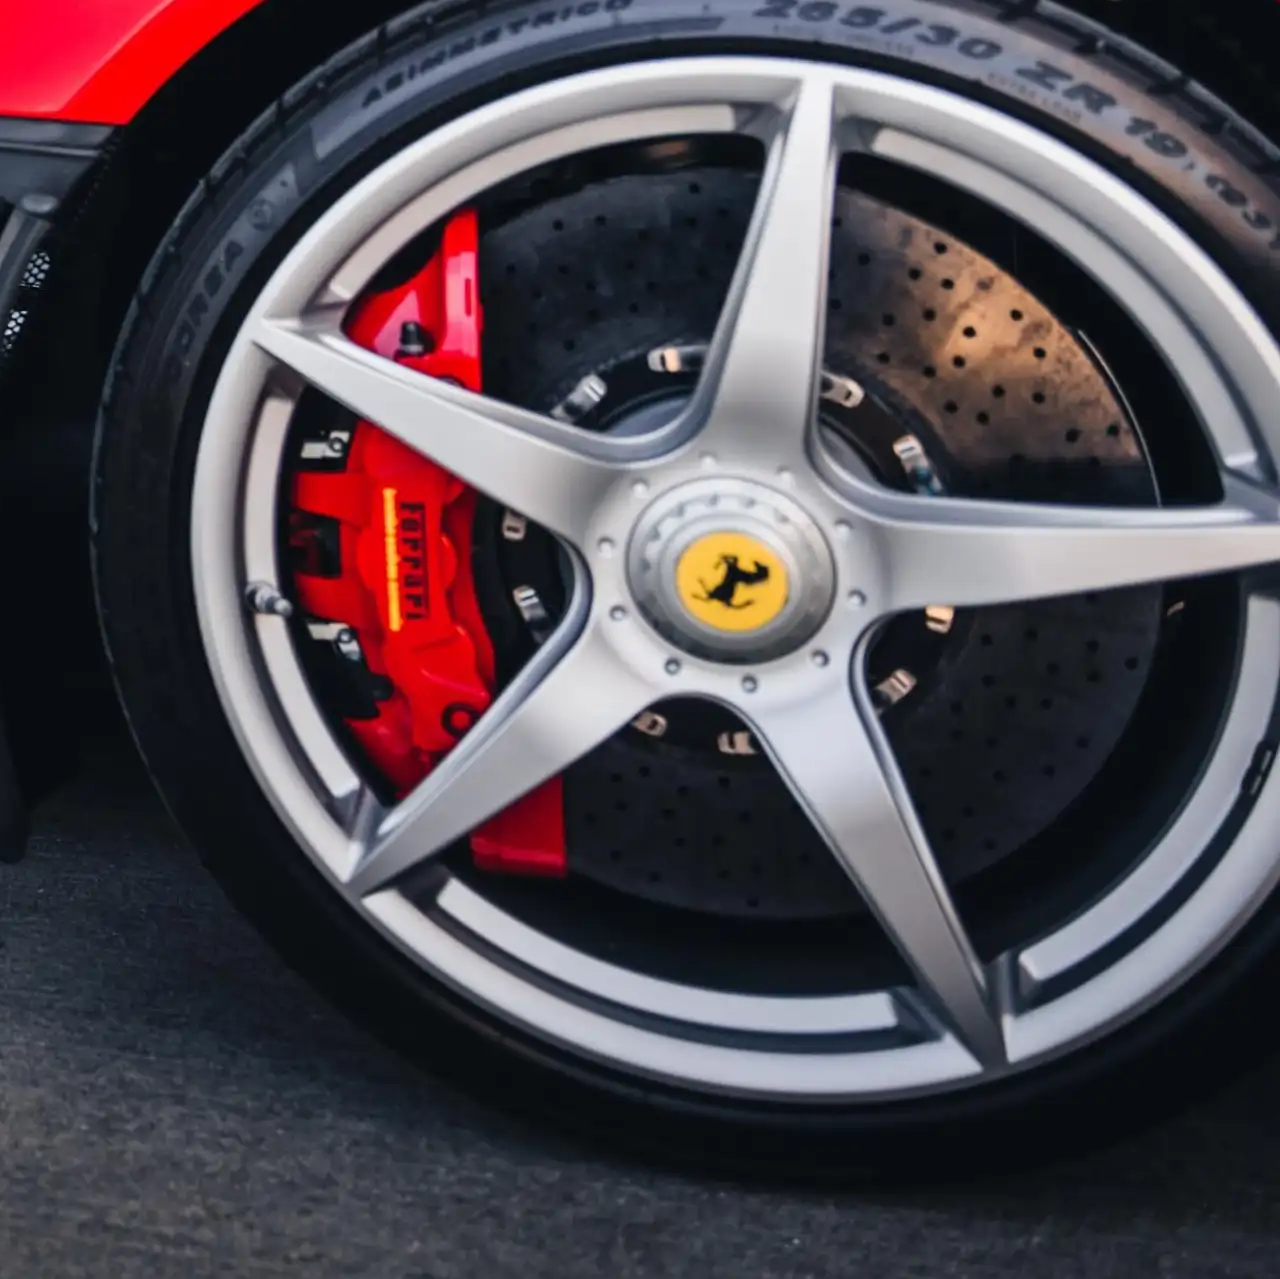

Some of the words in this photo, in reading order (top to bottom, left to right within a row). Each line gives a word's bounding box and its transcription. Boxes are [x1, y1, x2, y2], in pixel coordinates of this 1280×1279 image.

[1013, 59, 1118, 115] ZR
[1123, 115, 1189, 159] 19
[400, 501, 429, 620] Ferrari
